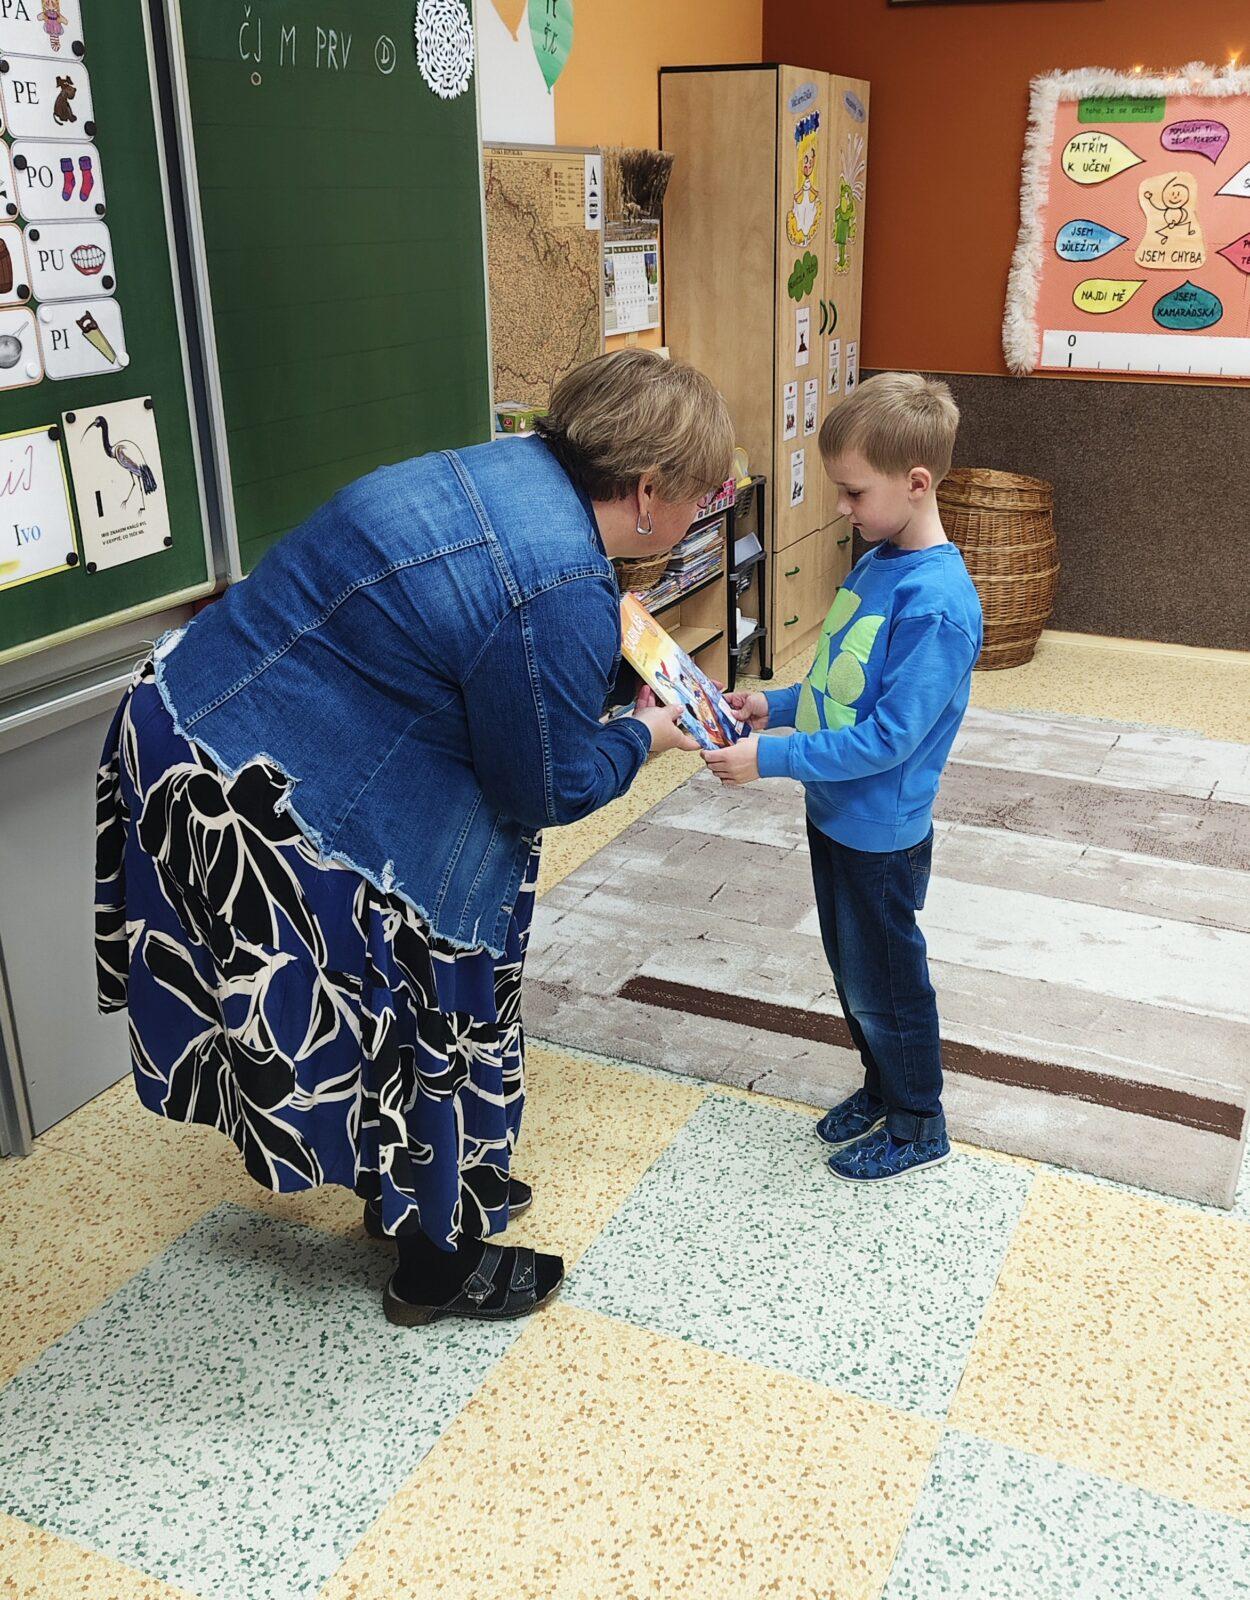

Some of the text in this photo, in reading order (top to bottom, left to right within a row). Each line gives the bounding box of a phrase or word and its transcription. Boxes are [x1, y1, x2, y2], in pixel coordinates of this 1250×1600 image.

[2, 0, 31, 21] PA
[239, 4, 262, 63] ČJ
[280, 25, 296, 67] M
[316, 26, 352, 70] PRV
[12, 80, 40, 105] PE
[1070, 136, 1108, 154] PATŘÍM
[1067, 157, 1112, 173] K UČENÍ
[25, 165, 54, 188] PO
[588, 165, 598, 186] A
[1071, 227, 1094, 237] JSEM
[1061, 239, 1101, 254] DŮLEŽITÁ
[38, 249, 65, 272] PU
[1139, 250, 1202, 263] JSEM CHYBA
[1081, 289, 1126, 302] NAJDI MĚ
[1173, 292, 1197, 301] JSEM
[1157, 304, 1218, 317] KAMARÁDSKÁ
[50, 328, 70, 351] PI
[1067, 334, 1077, 347] 0
[12, 523, 42, 547] Ivo
